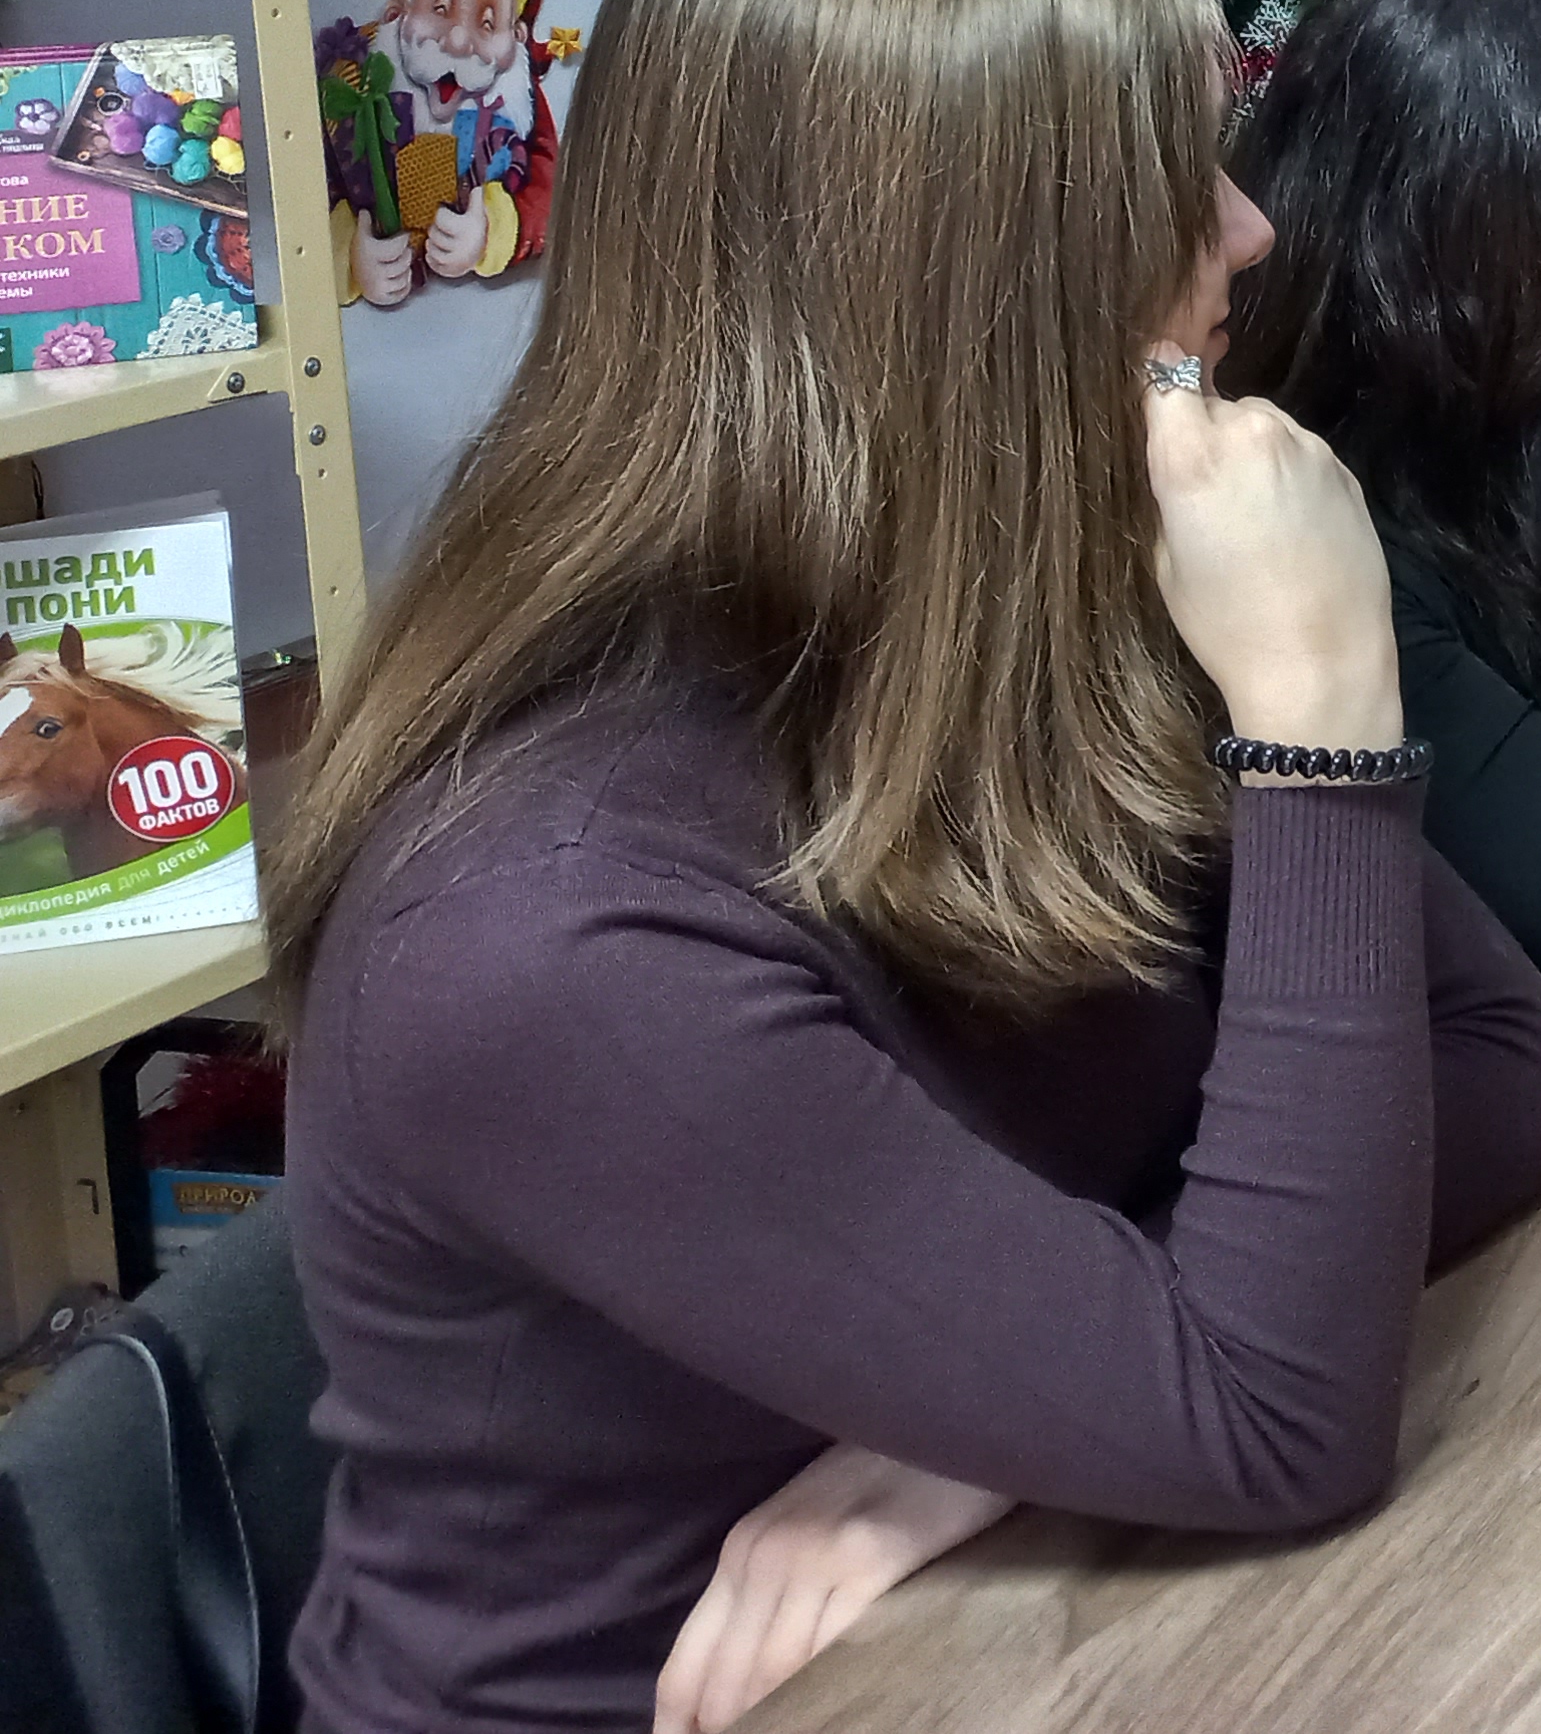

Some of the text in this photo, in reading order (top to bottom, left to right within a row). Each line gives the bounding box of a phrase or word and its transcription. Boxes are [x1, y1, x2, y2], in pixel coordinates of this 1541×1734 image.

[0, 175, 29, 187] ова
[0, 228, 106, 262] КОМ
[0, 285, 34, 299] емы
[0, 547, 156, 590] шади
[6, 585, 136, 625] пони
[118, 750, 220, 815] 100
[138, 797, 221, 832] ФАКТОВ
[118, 869, 151, 892] для
[156, 840, 211, 877] детей
